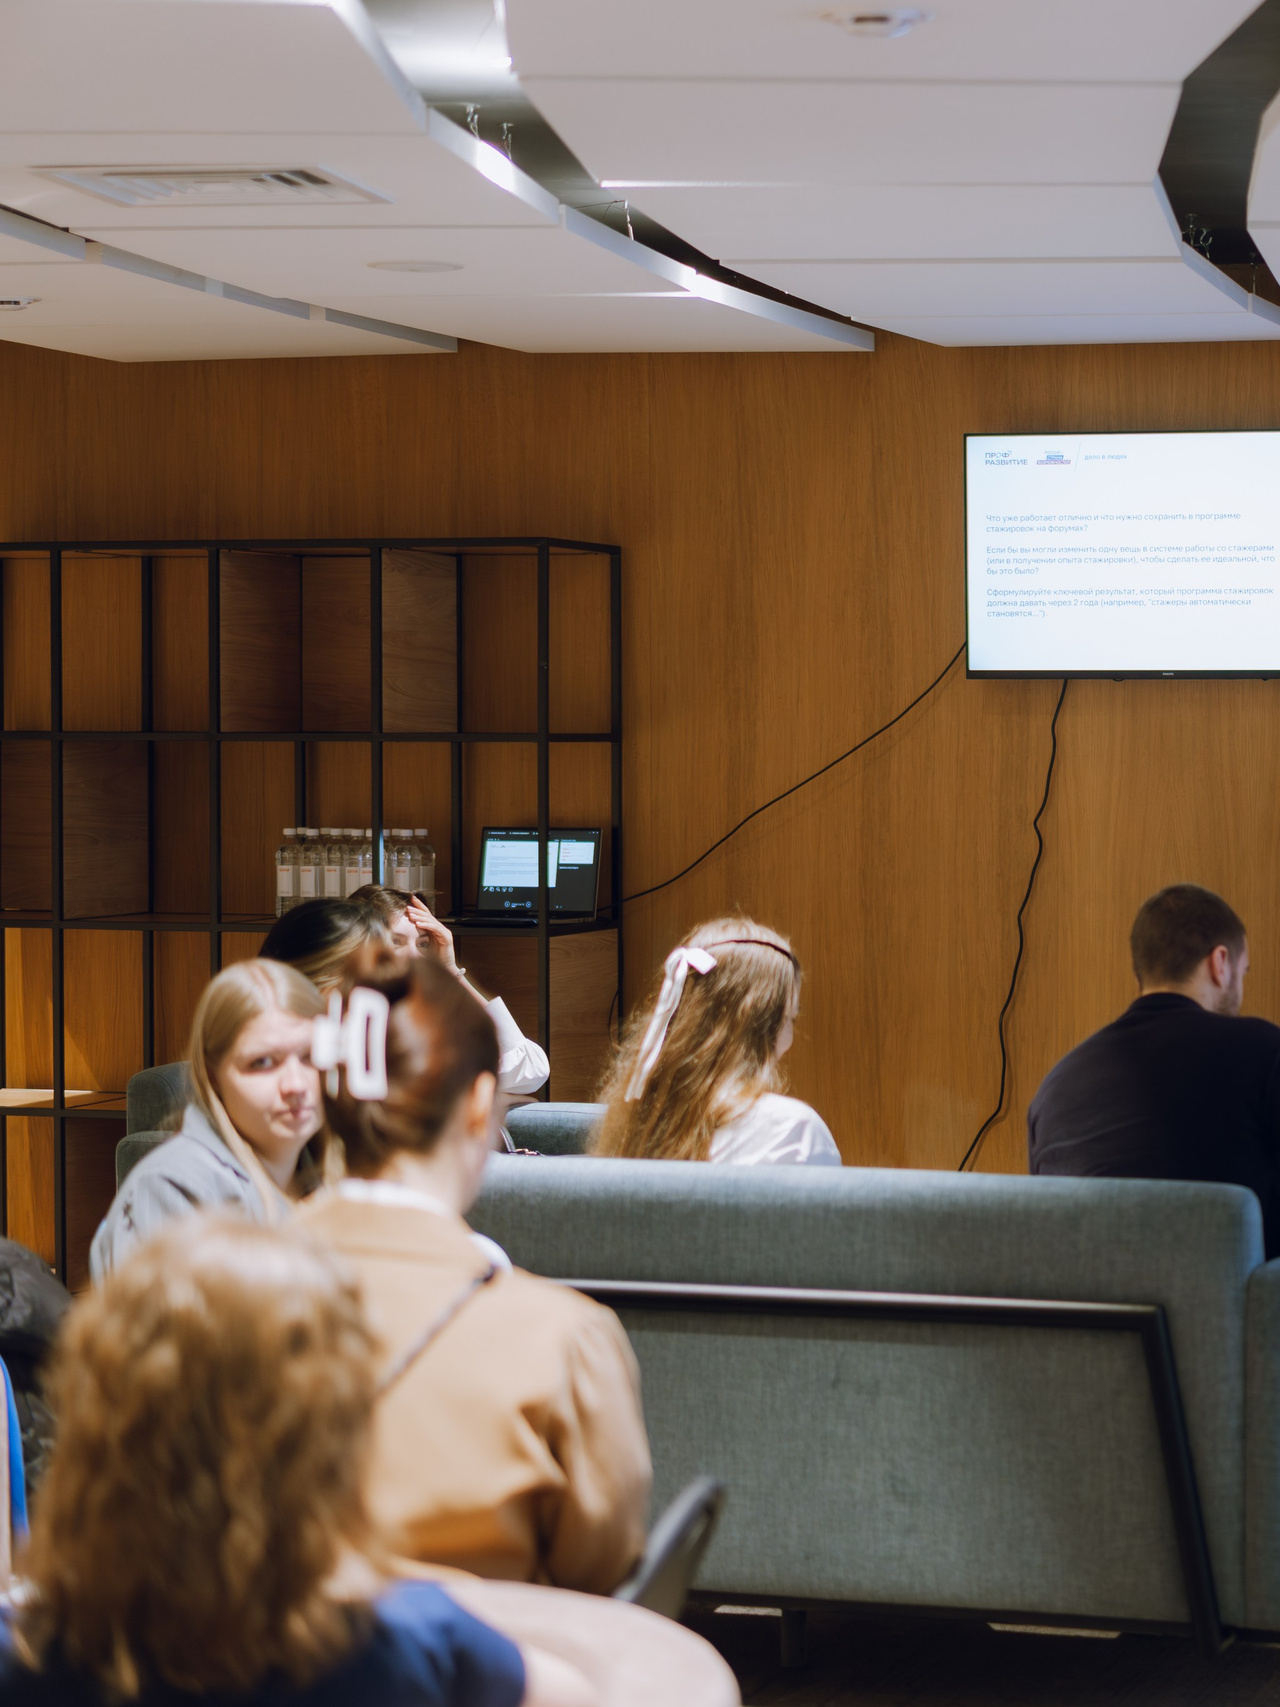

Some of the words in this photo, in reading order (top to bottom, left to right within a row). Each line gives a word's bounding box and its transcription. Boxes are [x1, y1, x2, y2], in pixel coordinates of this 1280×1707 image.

[986, 514, 1001, 522] Что
[1002, 515, 1019, 523] уже
[1020, 514, 1057, 522] работает
[1116, 514, 1143, 522] нужно
[1195, 513, 1241, 521] программе
[986, 525, 1035, 533] стажировок
[1048, 524, 1089, 533] форумах?
[986, 546, 1006, 554] Если
[1098, 546, 1118, 554] одну
[1119, 546, 1141, 554] вещь
[1184, 544, 1215, 553] работы
[1228, 544, 1275, 553] стажерами
[986, 557, 1005, 565] (или
[1013, 557, 1056, 565] получении
[1057, 556, 1083, 564] опыта
[1083, 555, 1139, 565] стажировки),
[1140, 555, 1166, 563] чтобы
[1166, 555, 1200, 563] сделать
[1212, 555, 1259, 563] идеальной,
[986, 567, 998, 575] бы
[999, 567, 1013, 575] это
[1014, 566, 1040, 575] было?
[986, 588, 1052, 597] Сформулируйте
[1053, 587, 1094, 596] ключевой
[1094, 588, 1138, 597] результат,
[1139, 587, 1176, 596] который
[1176, 588, 1223, 597] программа
[1223, 587, 1275, 596] стажировок
[986, 599, 1018, 608] должна
[1019, 599, 1048, 608] давать
[1048, 599, 1073, 607] через
[1073, 599, 1079, 607] 2
[1080, 599, 1099, 607] года
[1100, 598, 1147, 608] (например,
